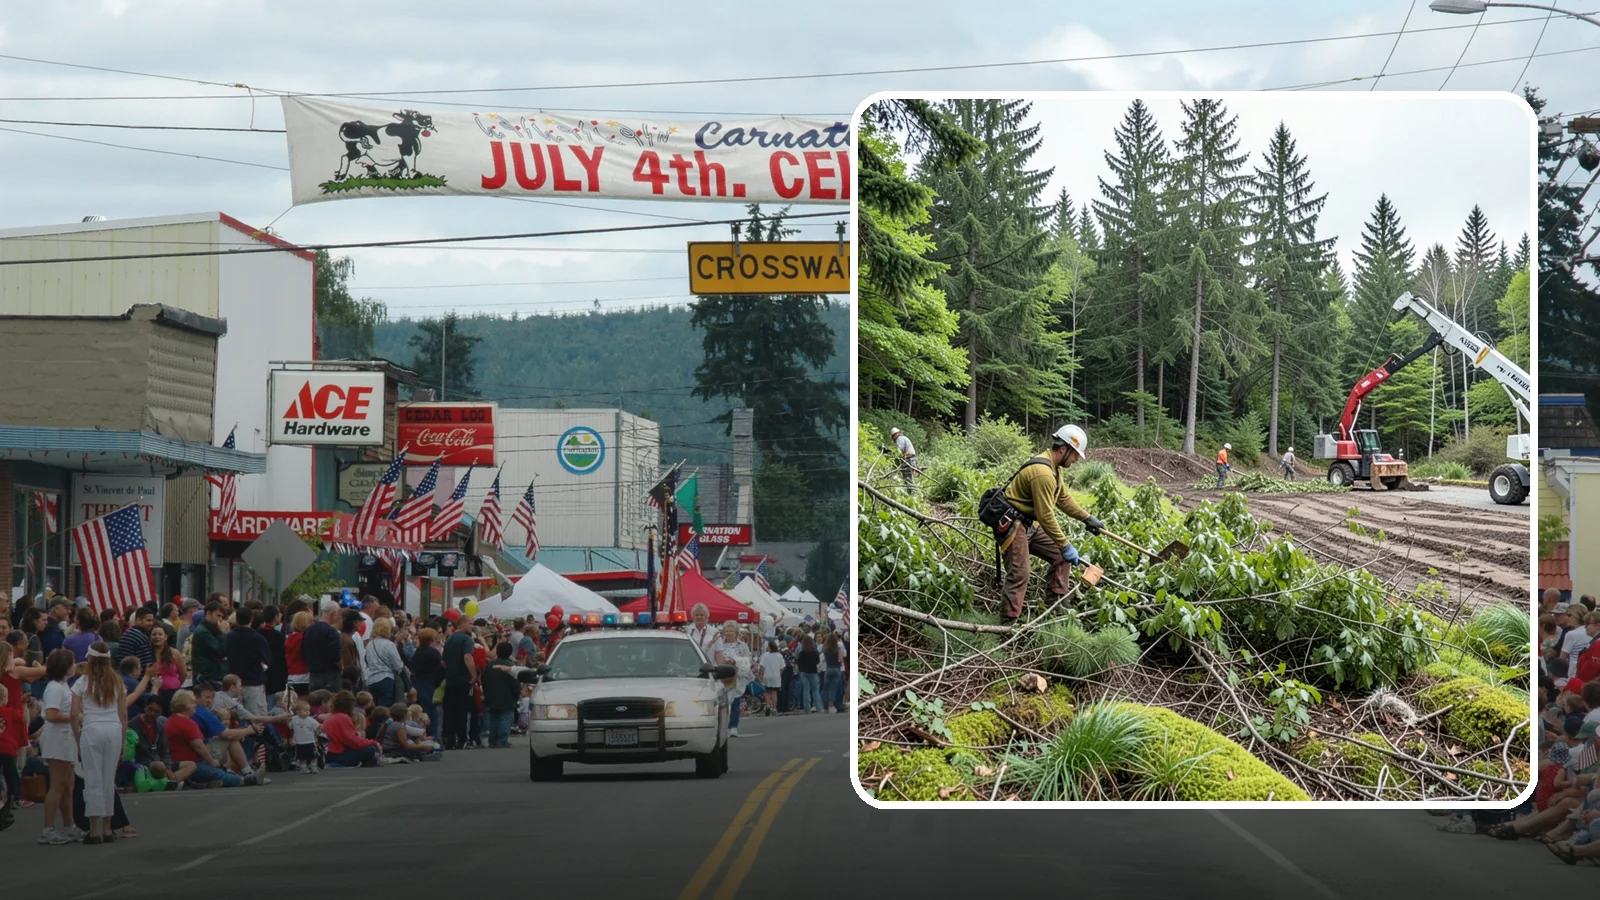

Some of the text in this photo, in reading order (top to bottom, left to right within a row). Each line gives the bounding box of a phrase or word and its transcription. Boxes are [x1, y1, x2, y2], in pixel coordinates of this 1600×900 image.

[694, 121, 850, 150] Carnat
[481, 141, 605, 192] JULY
[632, 150, 746, 197] 4th.
[697, 254, 850, 280] CROSSWA
[283, 380, 373, 420] ACE
[405, 408, 485, 421] CEDAR LOG
[284, 420, 370, 436] Hardware
[416, 428, 477, 446] Coca-Cola
[353, 467, 385, 479] Simpl
[95, 485, 124, 494] Vincent
[126, 485, 136, 494] de
[137, 486, 155, 495] Paul
[688, 526, 741, 536] CRNATION
[699, 535, 730, 543] GLASS
